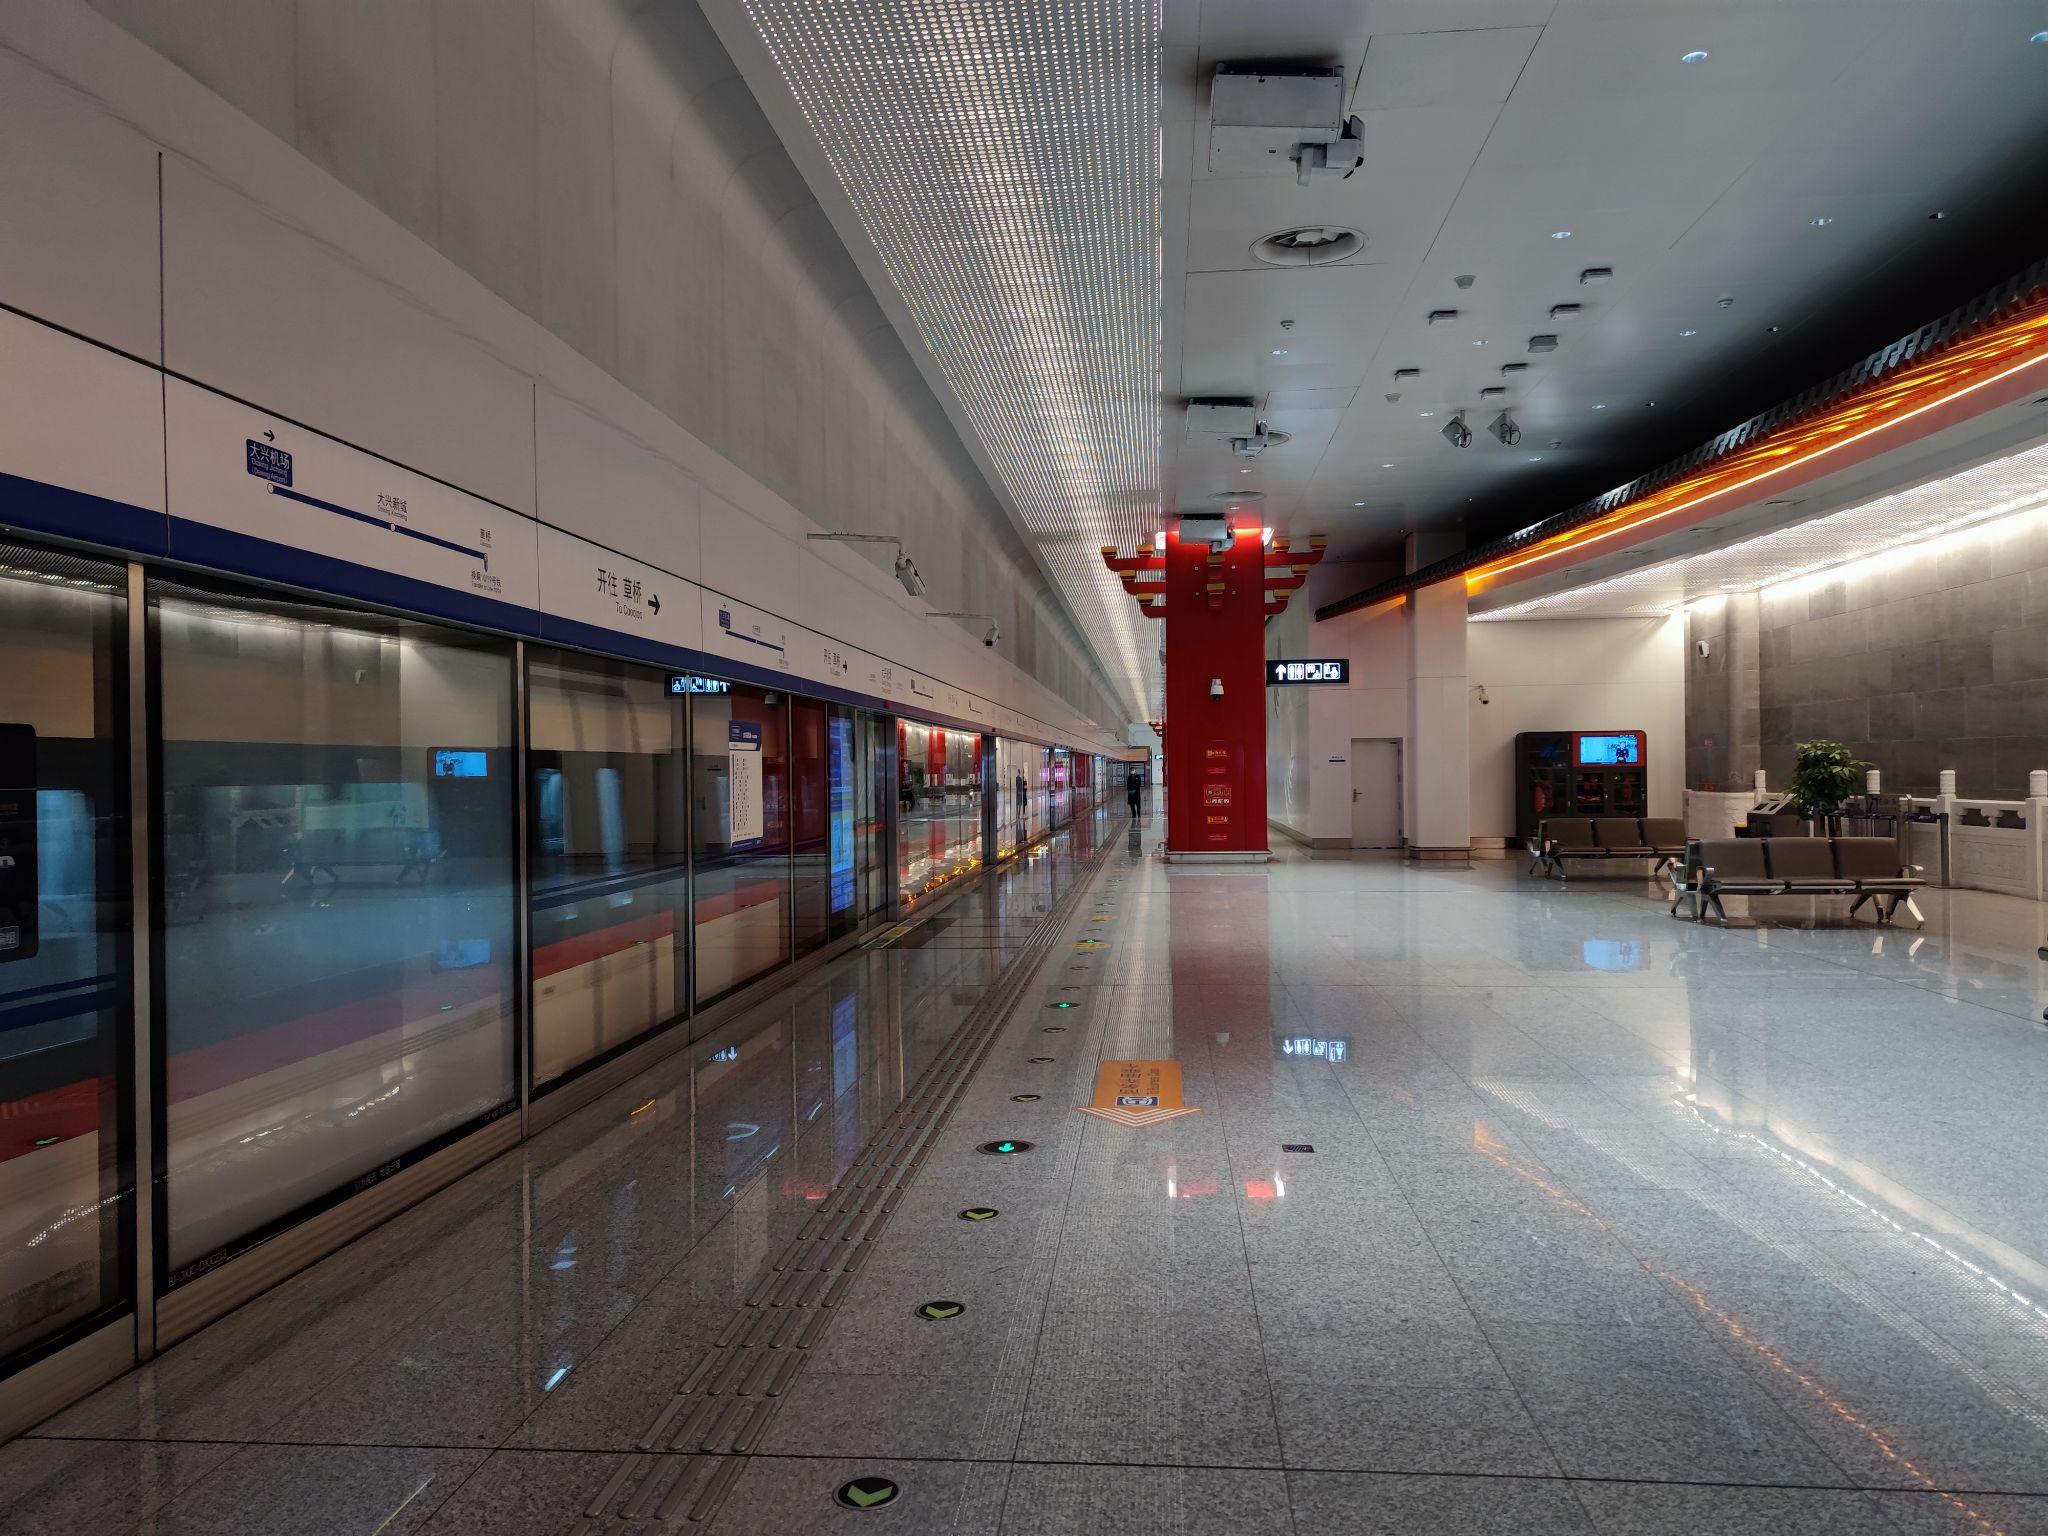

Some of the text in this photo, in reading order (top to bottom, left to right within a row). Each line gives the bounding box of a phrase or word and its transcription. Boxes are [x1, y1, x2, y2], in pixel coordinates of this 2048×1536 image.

[249, 443, 290, 469] 大兴机场
[377, 492, 407, 513] 大兴新城
[597, 567, 642, 605] 开往 草桥
[616, 601, 623, 614] To
